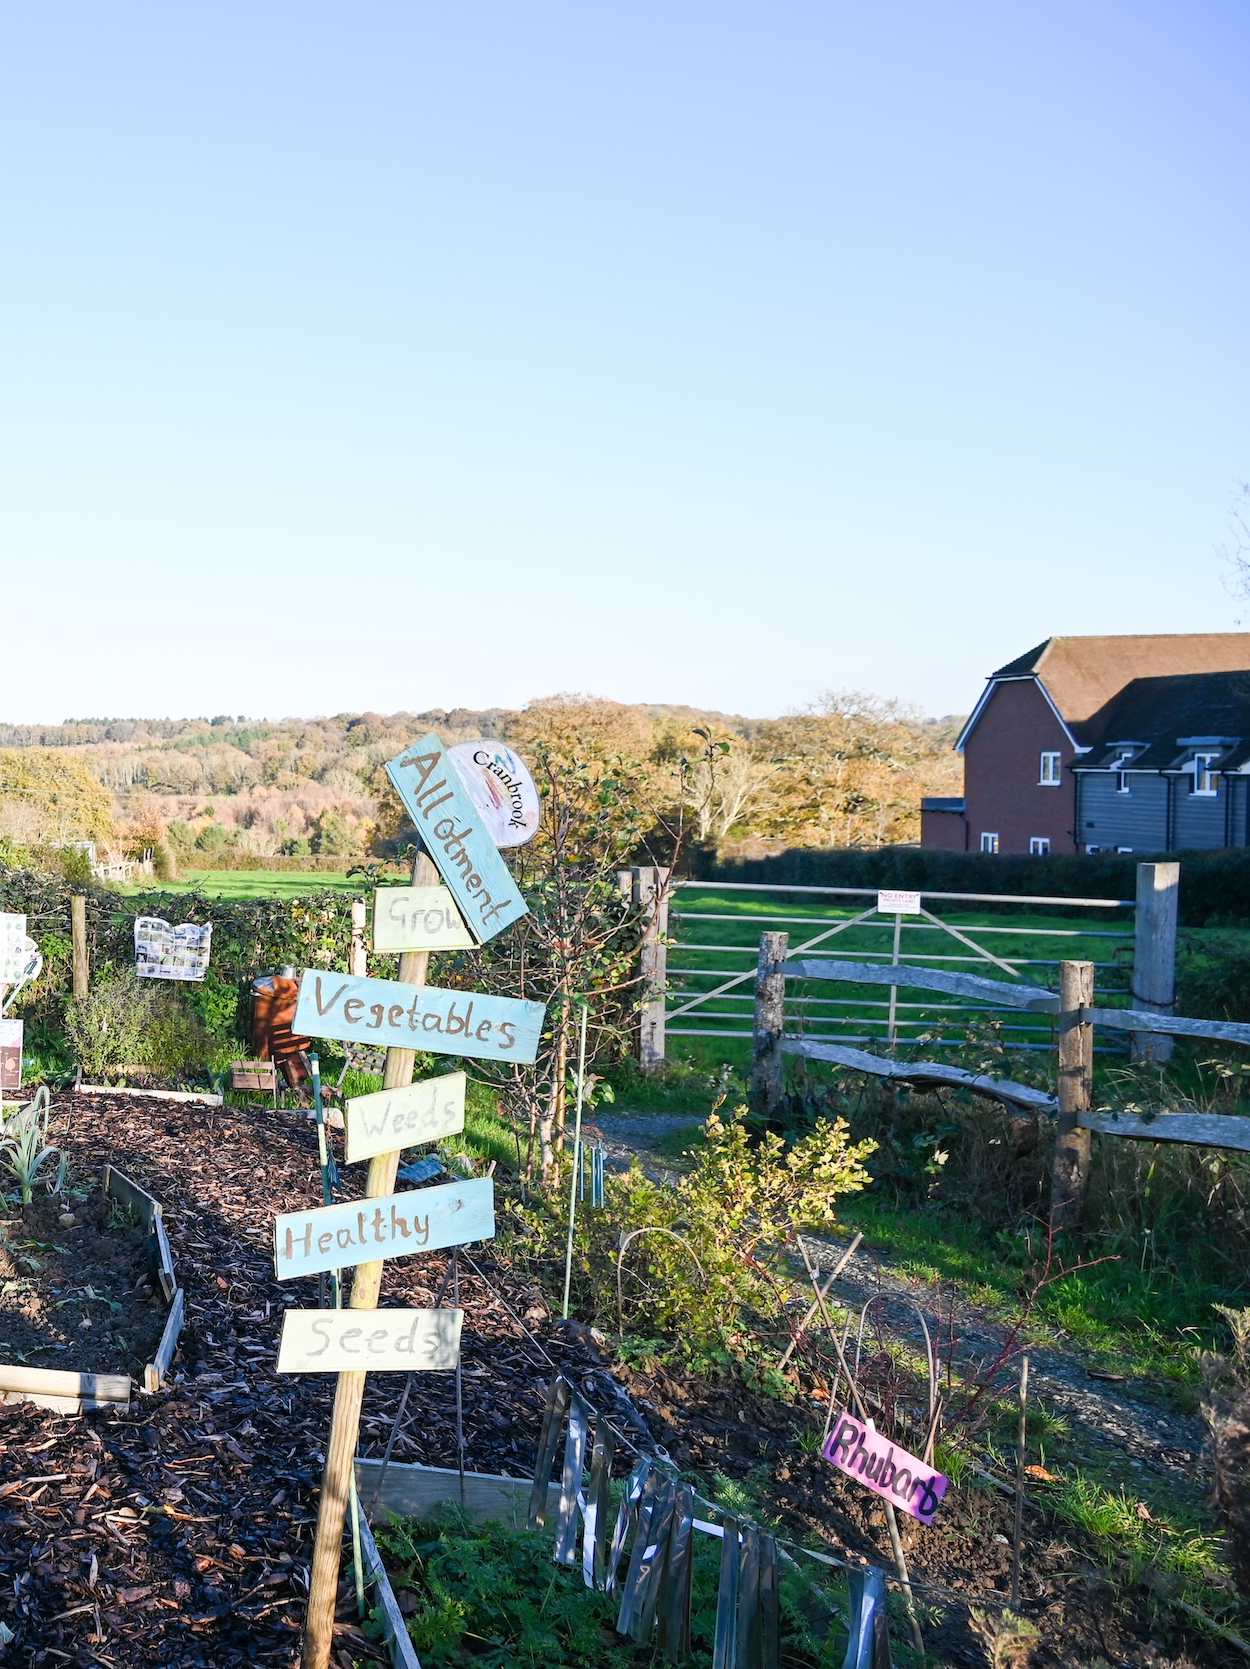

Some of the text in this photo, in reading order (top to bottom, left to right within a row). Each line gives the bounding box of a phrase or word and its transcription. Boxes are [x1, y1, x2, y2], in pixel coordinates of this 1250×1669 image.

[472, 750, 528, 830] Cranbrook
[400, 751, 512, 925] Allotment
[315, 976, 517, 1050] Vegetables
[359, 1085, 456, 1140] Weeds
[285, 1204, 430, 1260] Healthy
[306, 1316, 441, 1357] Seeds
[829, 1418, 939, 1516] Rhubarb
